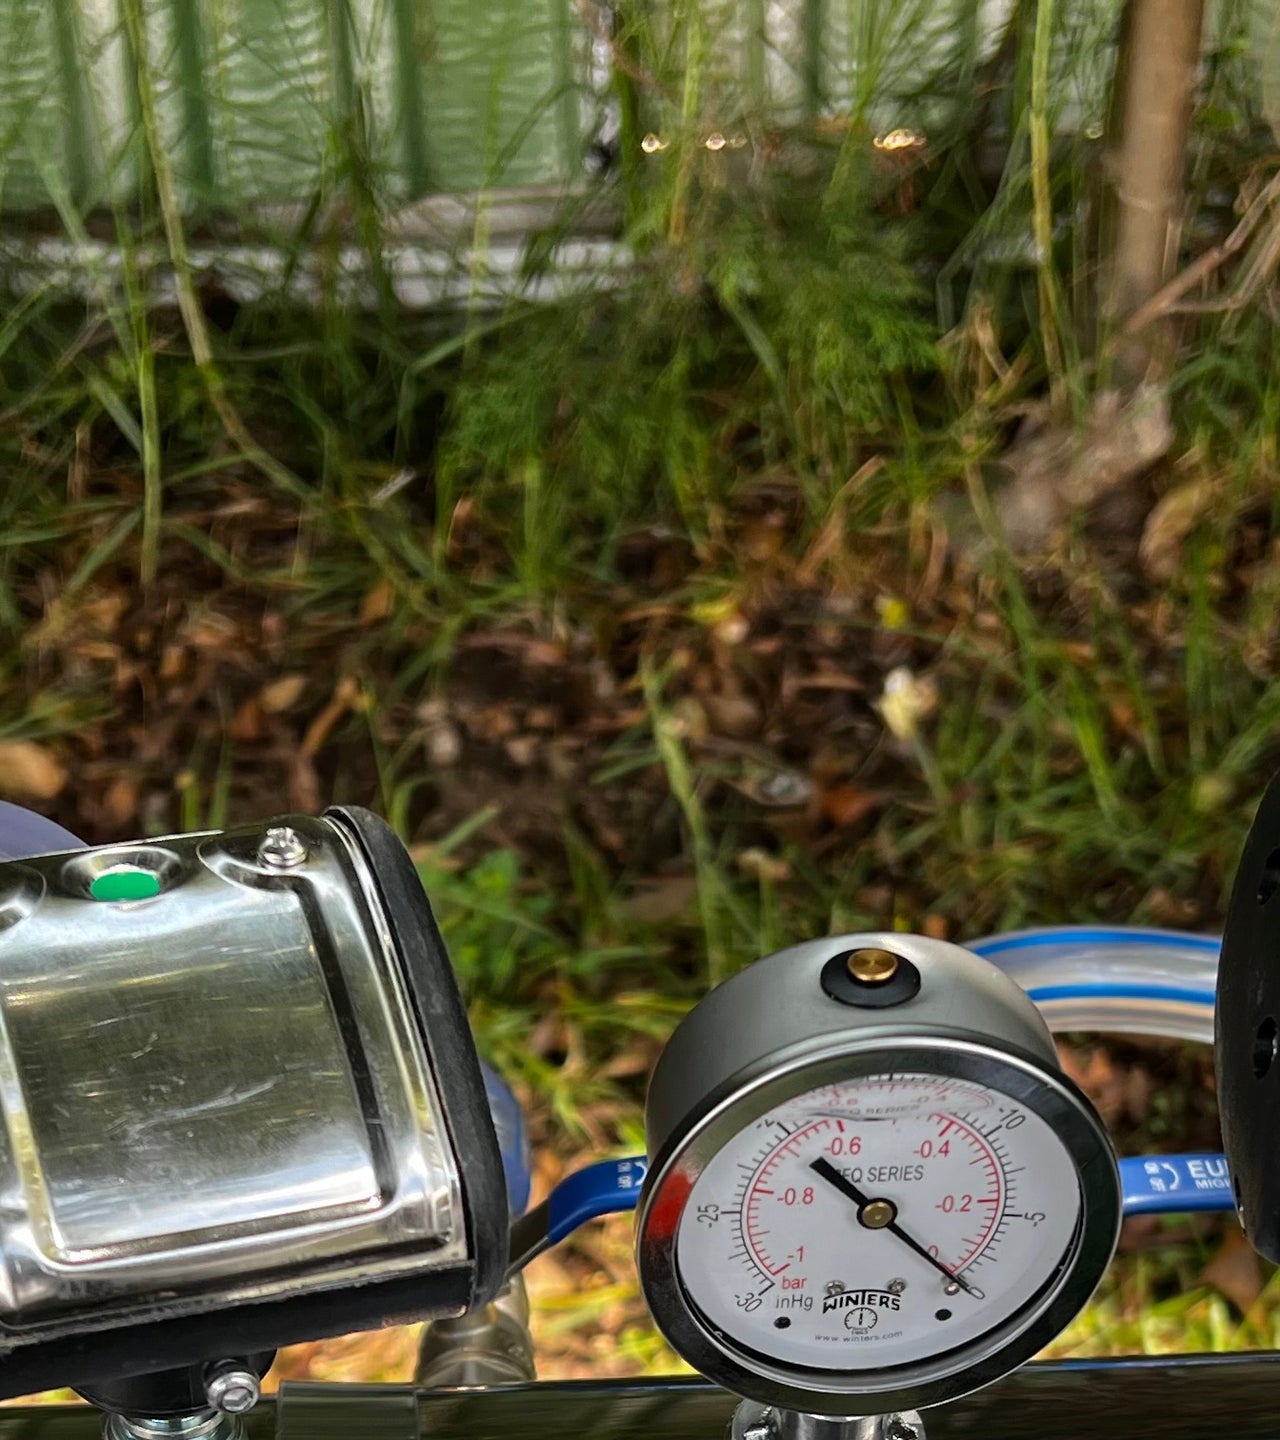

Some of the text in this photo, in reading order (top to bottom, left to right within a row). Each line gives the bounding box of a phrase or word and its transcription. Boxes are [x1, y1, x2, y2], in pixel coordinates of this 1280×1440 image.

[998, 1106, 1027, 1130] -10
[823, 1136, 861, 1156] -0.6
[913, 1139, 950, 1159] -0.4
[867, 1165, 924, 1183] SERIES
[1186, 1159, 1229, 1179] EU
[776, 1186, 814, 1206] -0.8
[934, 1194, 973, 1213] -0.2
[696, 1203, 719, 1229] -25
[1023, 1211, 1046, 1228] -5
[786, 1245, 805, 1263] -1
[781, 1275, 808, 1290] bar
[733, 1291, 763, 1313] -30
[775, 1294, 814, 1312] inHg
[821, 1289, 901, 1315] WINTERS
